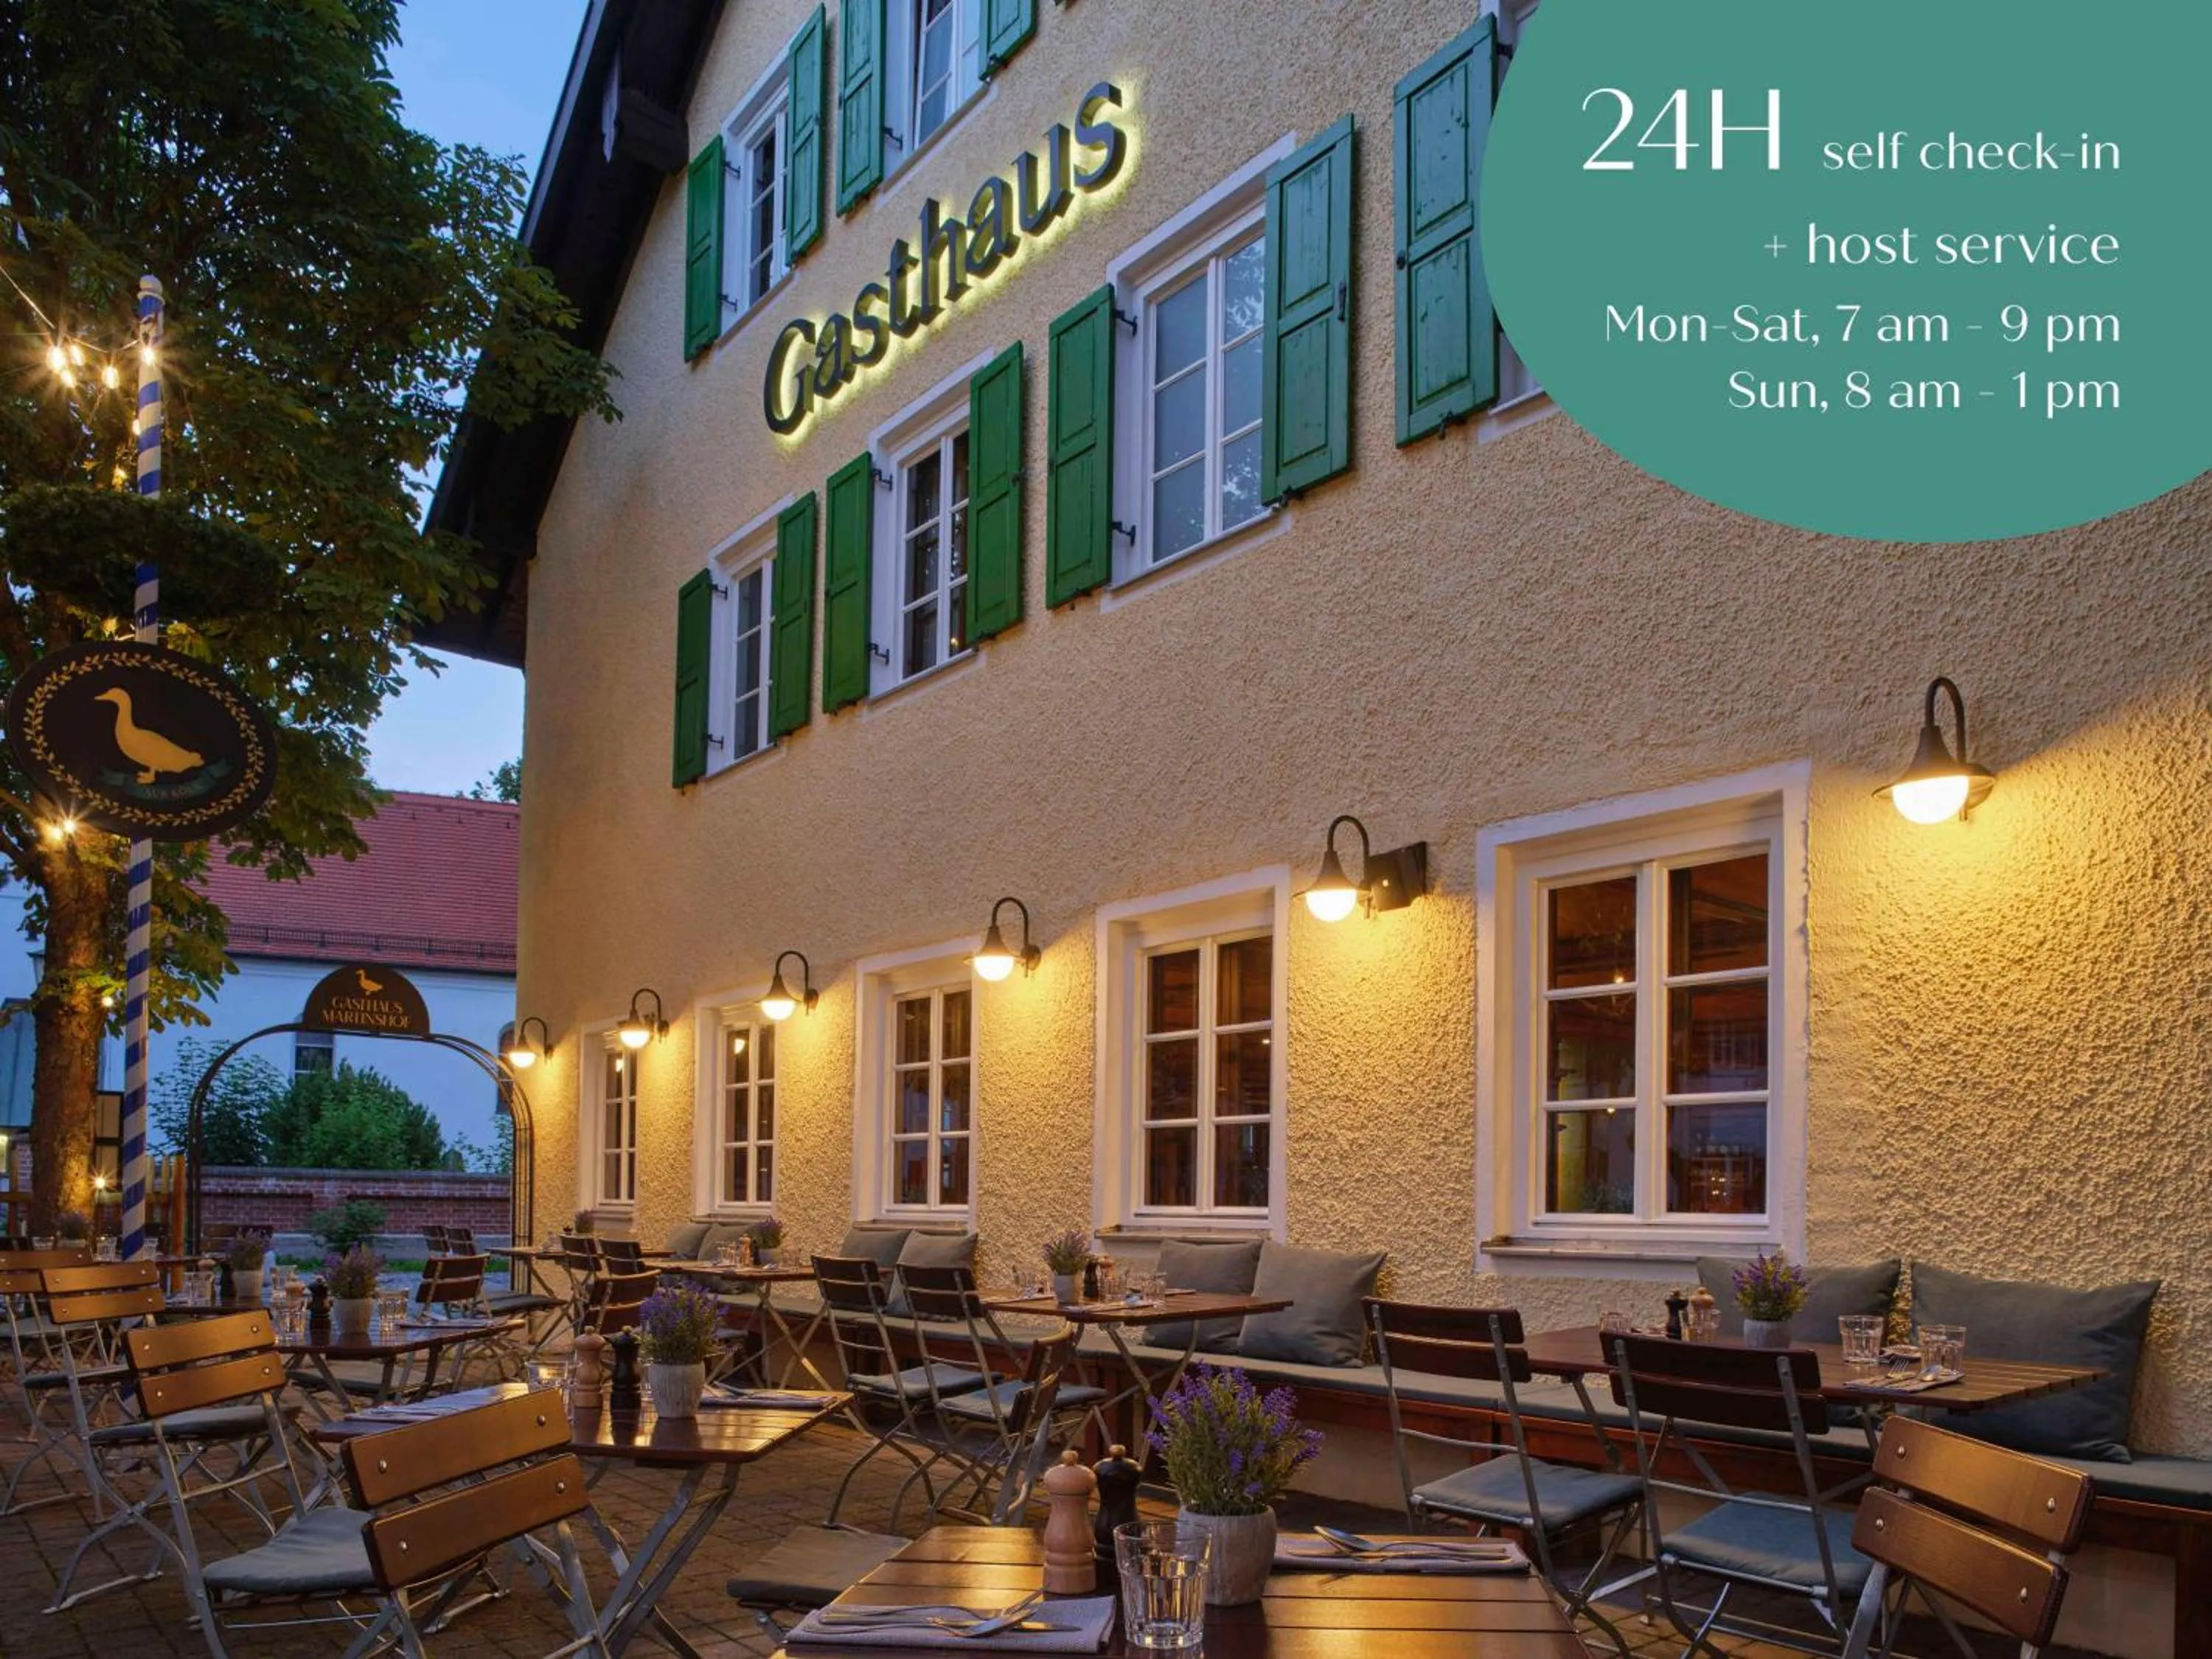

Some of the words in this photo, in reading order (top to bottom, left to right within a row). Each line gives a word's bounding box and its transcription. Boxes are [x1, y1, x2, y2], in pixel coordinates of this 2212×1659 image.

[764, 81, 1127, 435] Gasthaus
[332, 996, 403, 1014] GASTHAUS
[322, 1009, 411, 1029] MARTINSHOF
